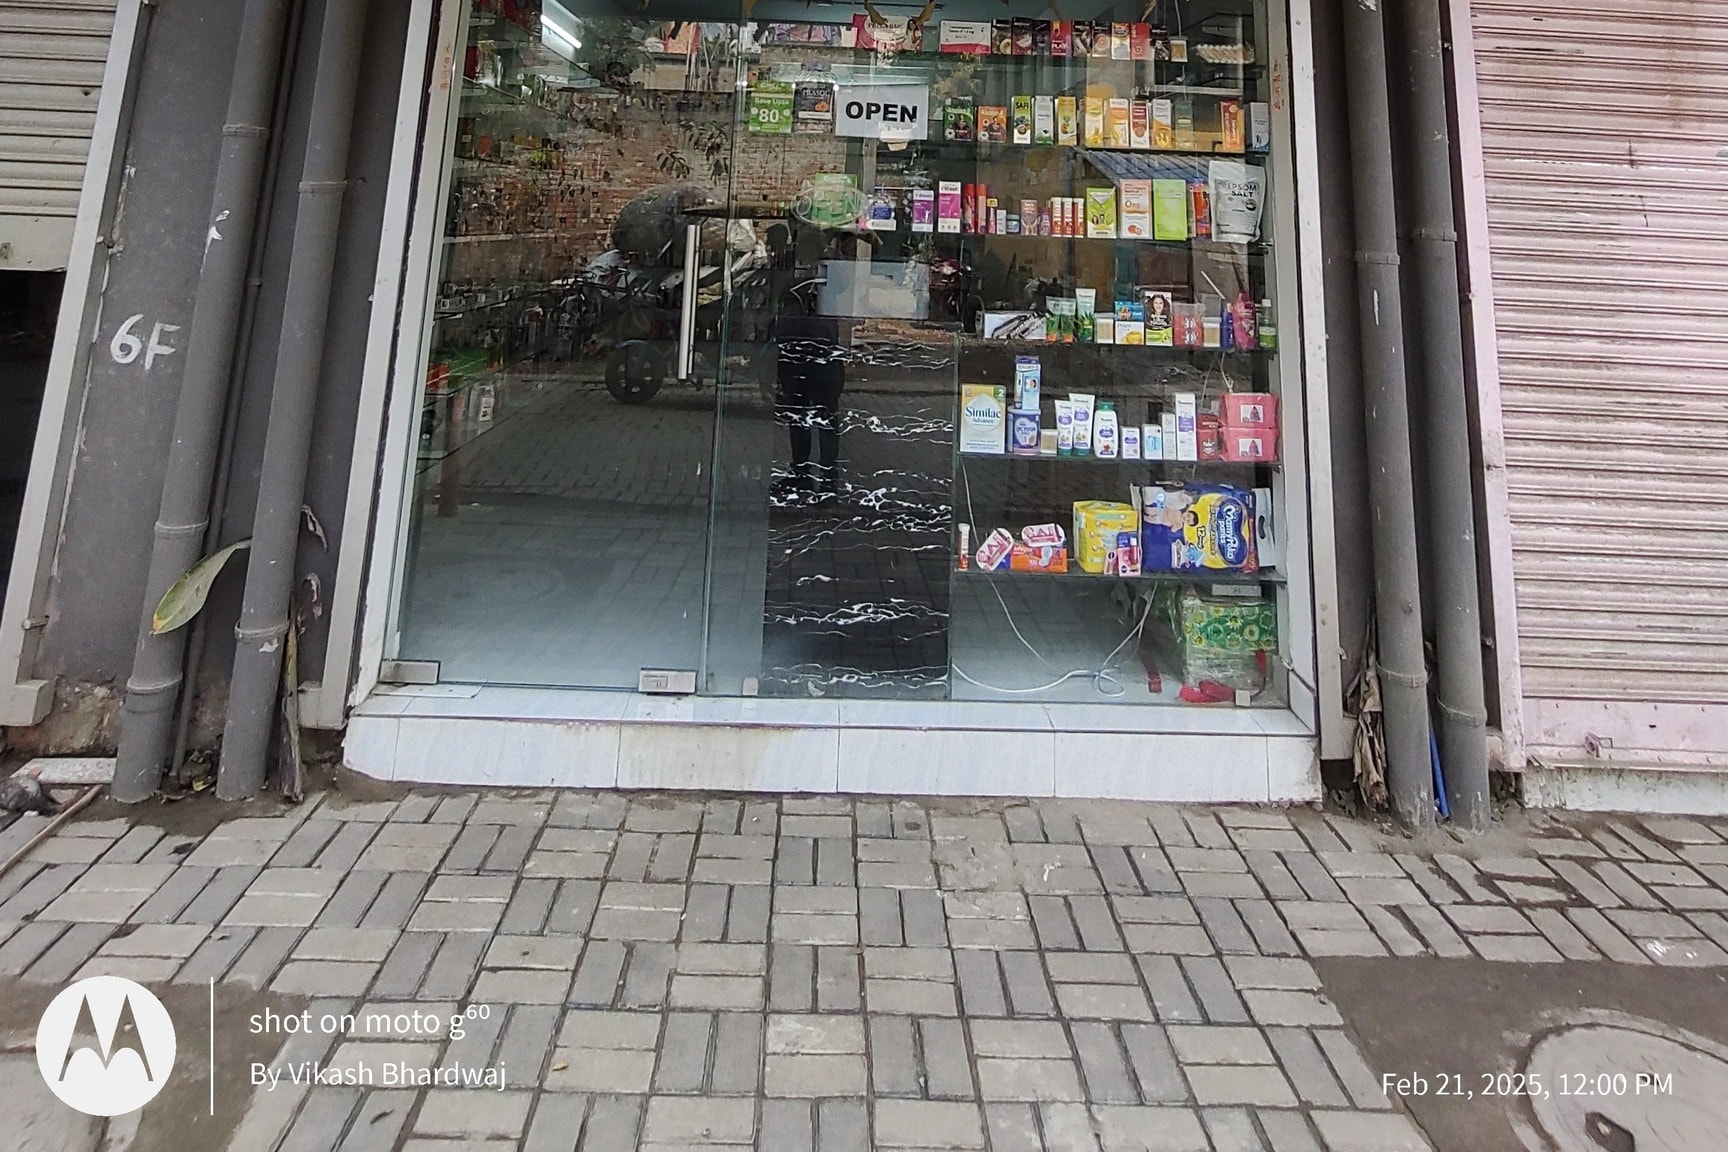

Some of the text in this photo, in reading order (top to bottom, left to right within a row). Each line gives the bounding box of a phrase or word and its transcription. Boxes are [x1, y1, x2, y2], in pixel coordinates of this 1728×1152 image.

[1015, 101, 1029, 109] SAFI
[845, 100, 918, 123] OPEN
[1227, 181, 1257, 192] EPSOM
[1231, 190, 1254, 198] SALT
[109, 312, 182, 372] 6F
[965, 406, 1001, 419] Similac
